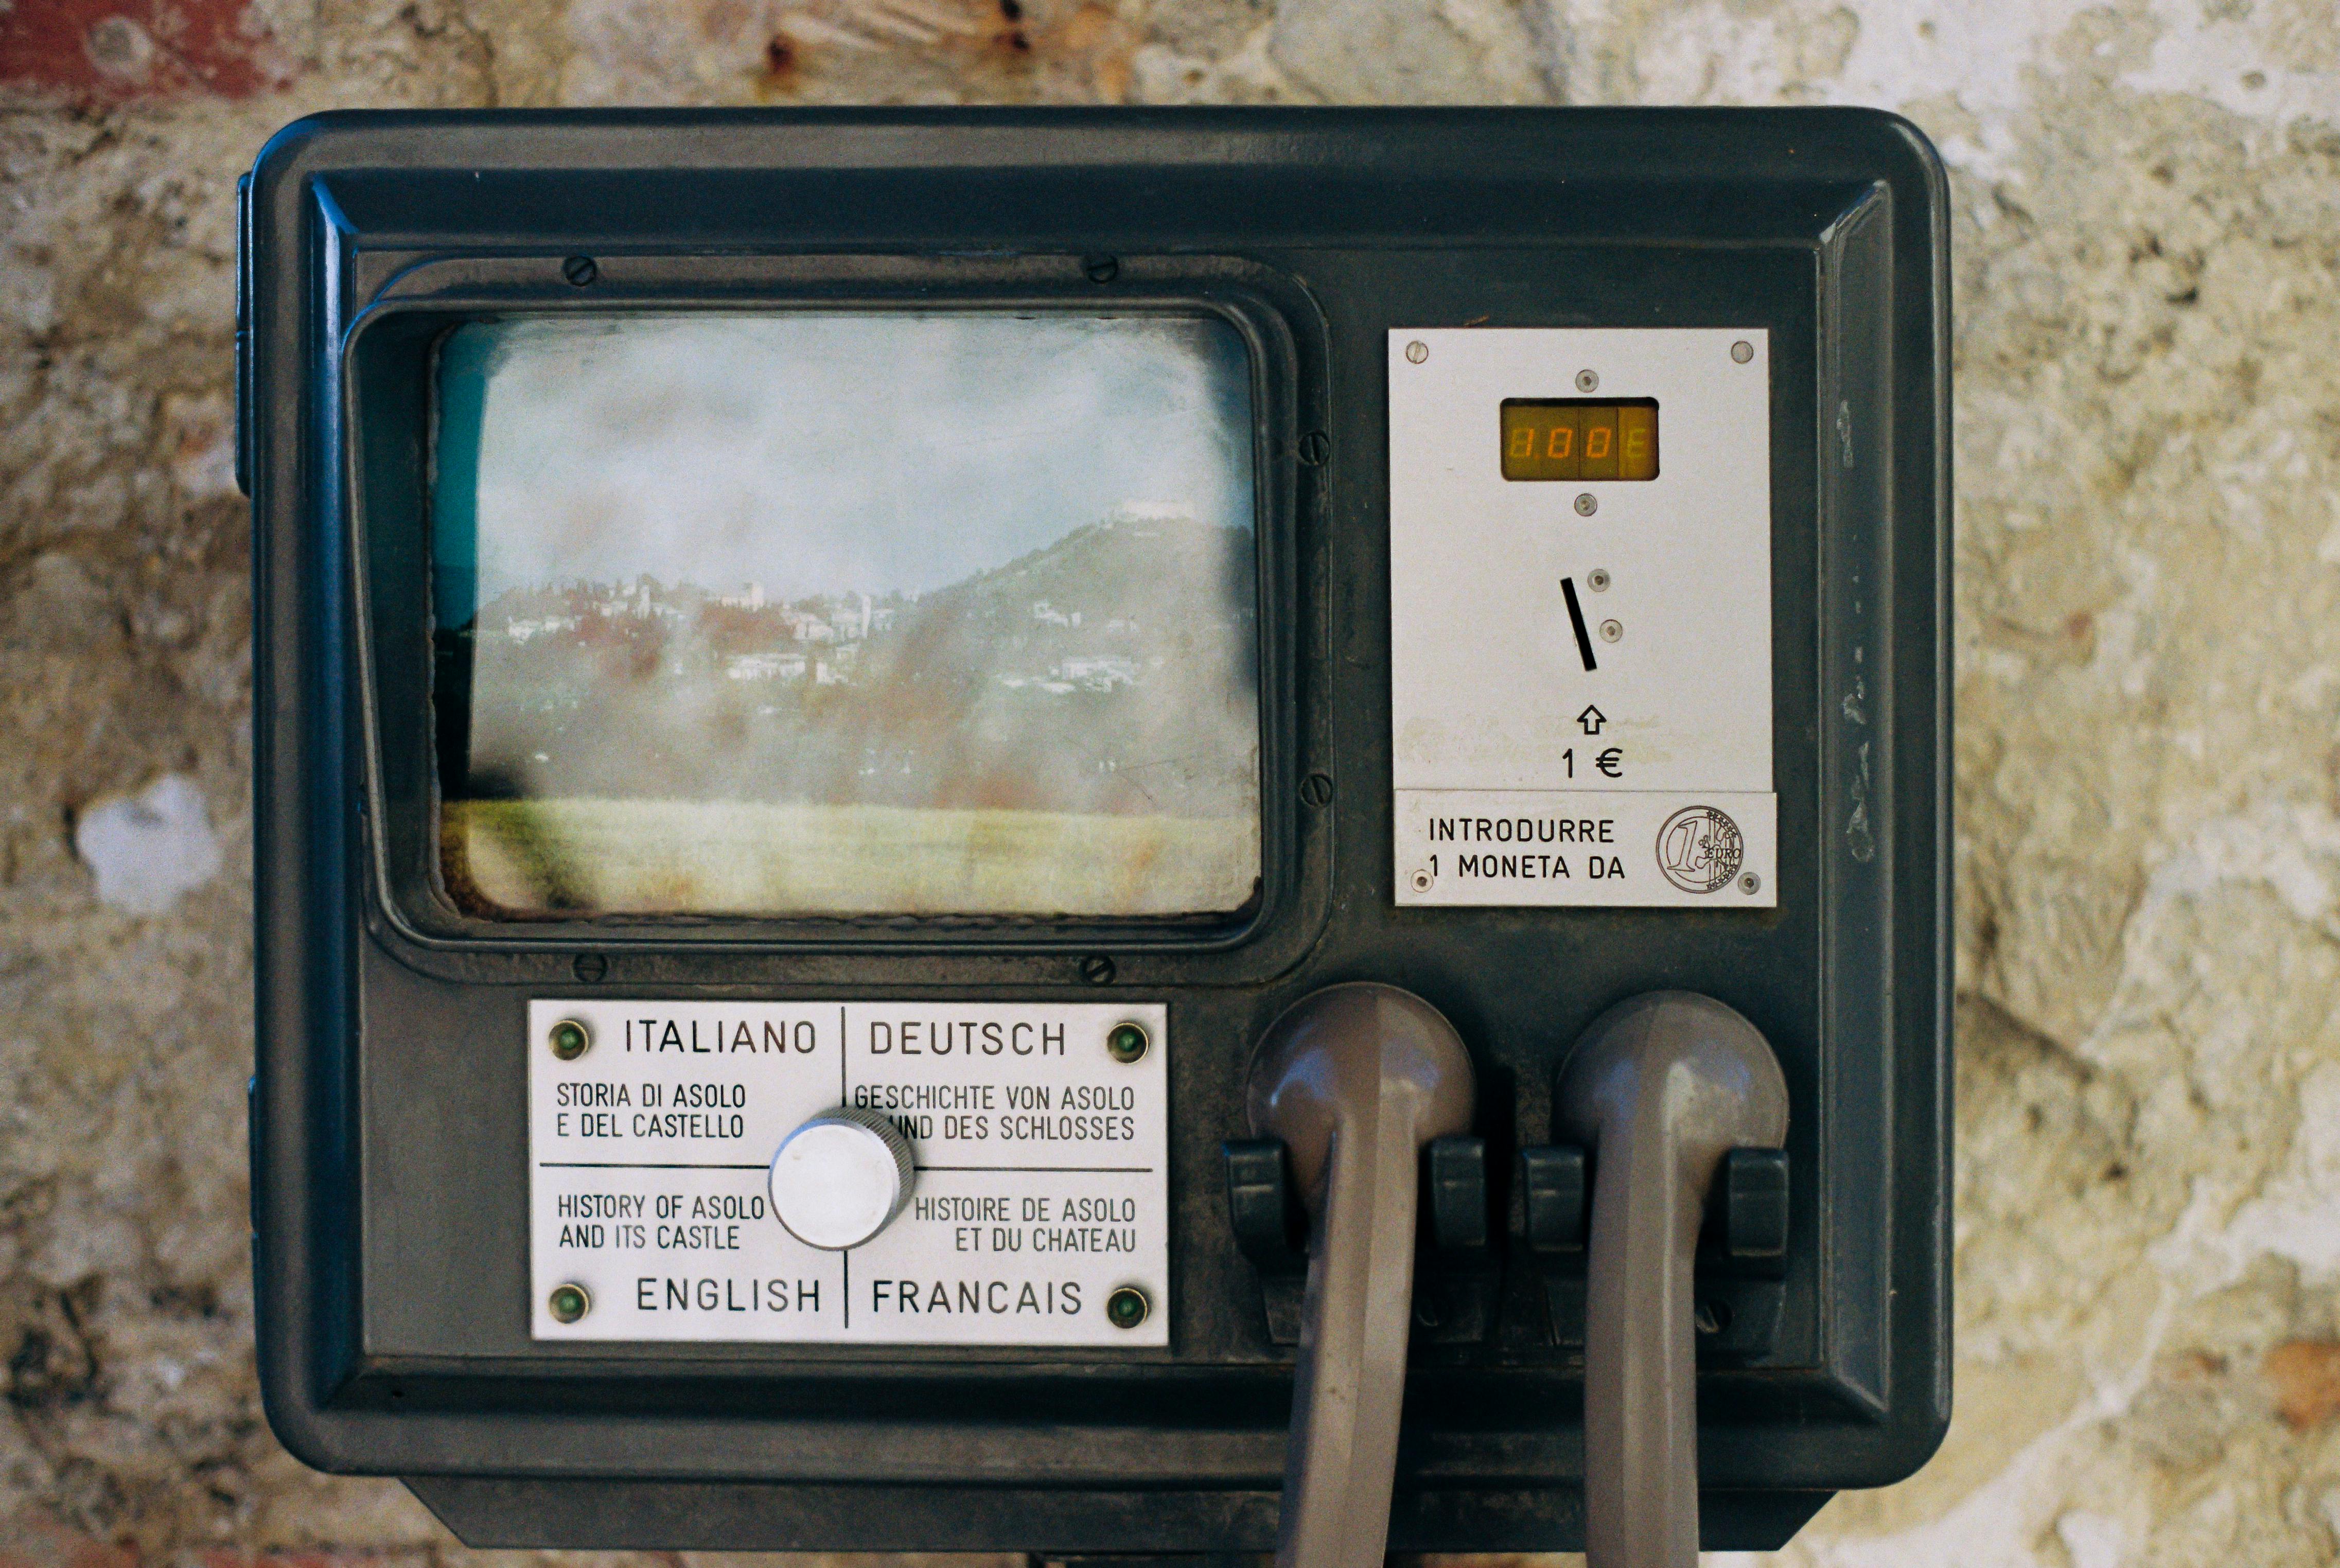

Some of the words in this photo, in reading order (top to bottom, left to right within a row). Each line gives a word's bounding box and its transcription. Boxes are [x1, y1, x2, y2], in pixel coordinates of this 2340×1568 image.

[1562, 748, 1573, 779] 1
[1595, 747, 1623, 778] €
[1430, 818, 1614, 843] INTRODURRE
[1666, 820, 1698, 872] 1
[1704, 848, 1741, 859] EURO
[1429, 854, 1438, 877] 1
[1458, 854, 1570, 879] MONETA
[1589, 855, 1625, 879] DA
[626, 1019, 816, 1054] ITALIANO
[871, 1021, 1064, 1056] DEUTSCH
[557, 1083, 631, 1107] STORIA
[642, 1083, 662, 1107] DI
[673, 1083, 746, 1108] ASOLO
[855, 1084, 995, 1110] GESCHICHTE
[1006, 1086, 1049, 1110] VON
[1061, 1086, 1134, 1111] ASOLO
[557, 1113, 569, 1137] E
[581, 1113, 623, 1137] DEL
[633, 1114, 744, 1138] CASTELLO
[945, 1115, 988, 1140] DES
[1000, 1116, 1134, 1140] SCHLOSSES
[558, 1194, 645, 1219] HISTORY
[656, 1195, 684, 1219] OF
[692, 1195, 764, 1220] ASOLO
[916, 1197, 1010, 1221] HISTOIRE
[1023, 1197, 1050, 1222] DE
[1062, 1197, 1135, 1222] ASOLO
[559, 1224, 605, 1248] AND
[616, 1225, 646, 1249] ITS
[657, 1225, 740, 1250] CASTLE
[956, 1227, 982, 1252] ET
[993, 1227, 1022, 1252] DU
[1033, 1227, 1135, 1253] CHATEAU
[638, 1277, 819, 1312] ENGLISH
[873, 1280, 1081, 1315] FRANCAIS
